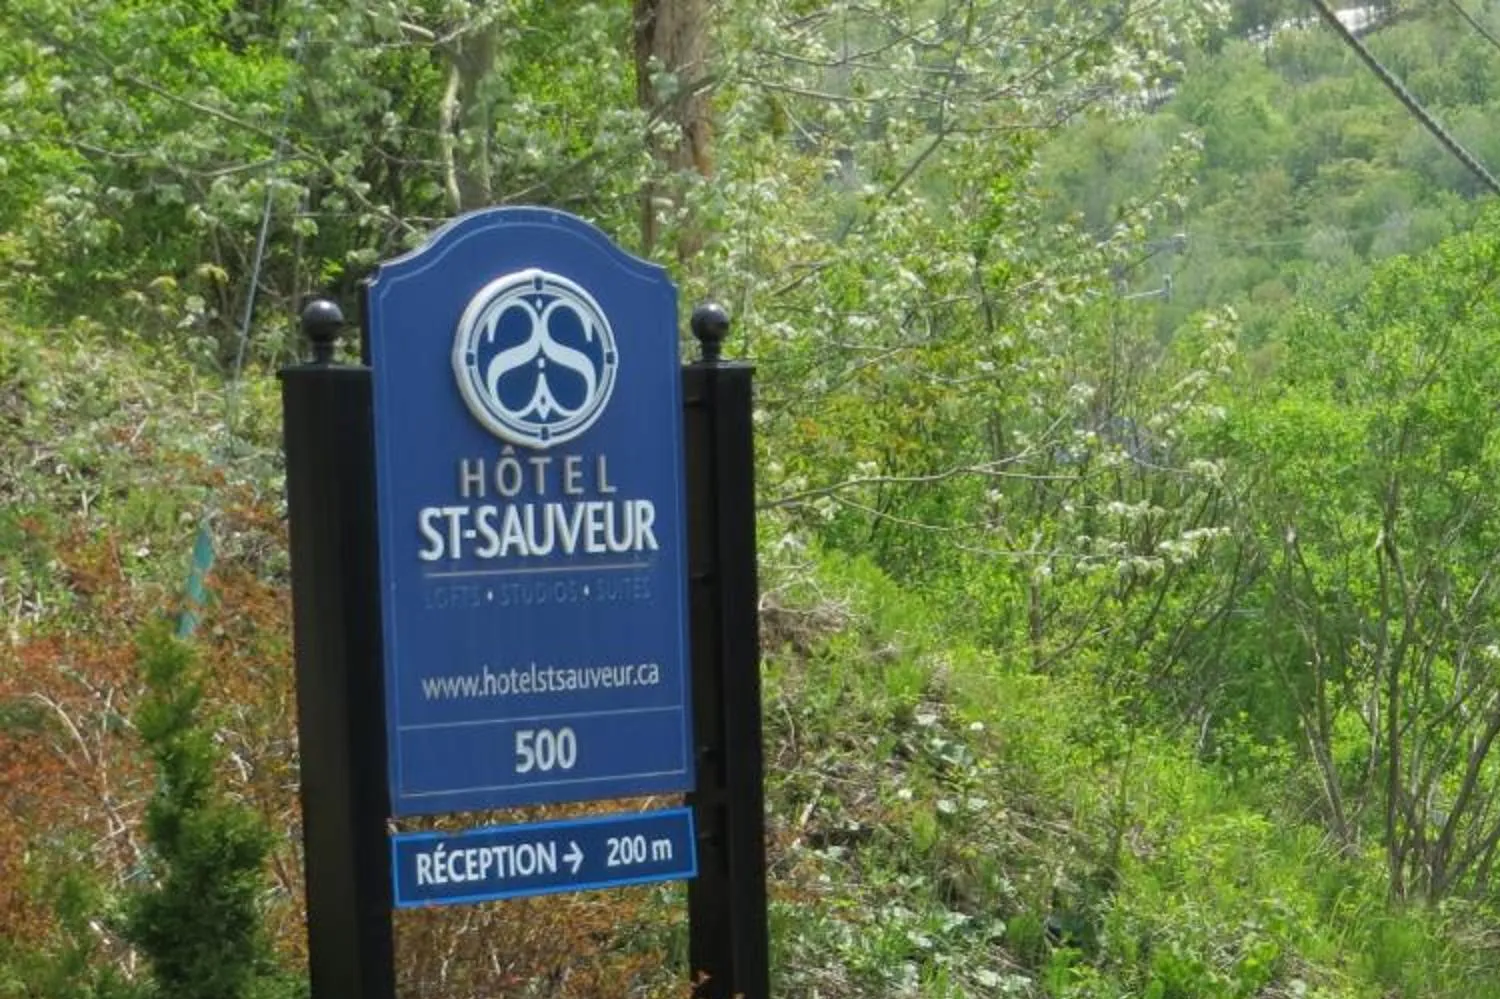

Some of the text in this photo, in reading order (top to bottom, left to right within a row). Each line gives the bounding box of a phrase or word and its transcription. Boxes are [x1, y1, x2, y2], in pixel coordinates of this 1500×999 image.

[460, 445, 617, 499] HÔTEL
[418, 499, 660, 562] ST-SAUVEUR
[421, 662, 660, 701] www.hotelstsauveur.ca
[514, 726, 578, 774] 500
[416, 834, 673, 885] RÉCEPTION 200 m
